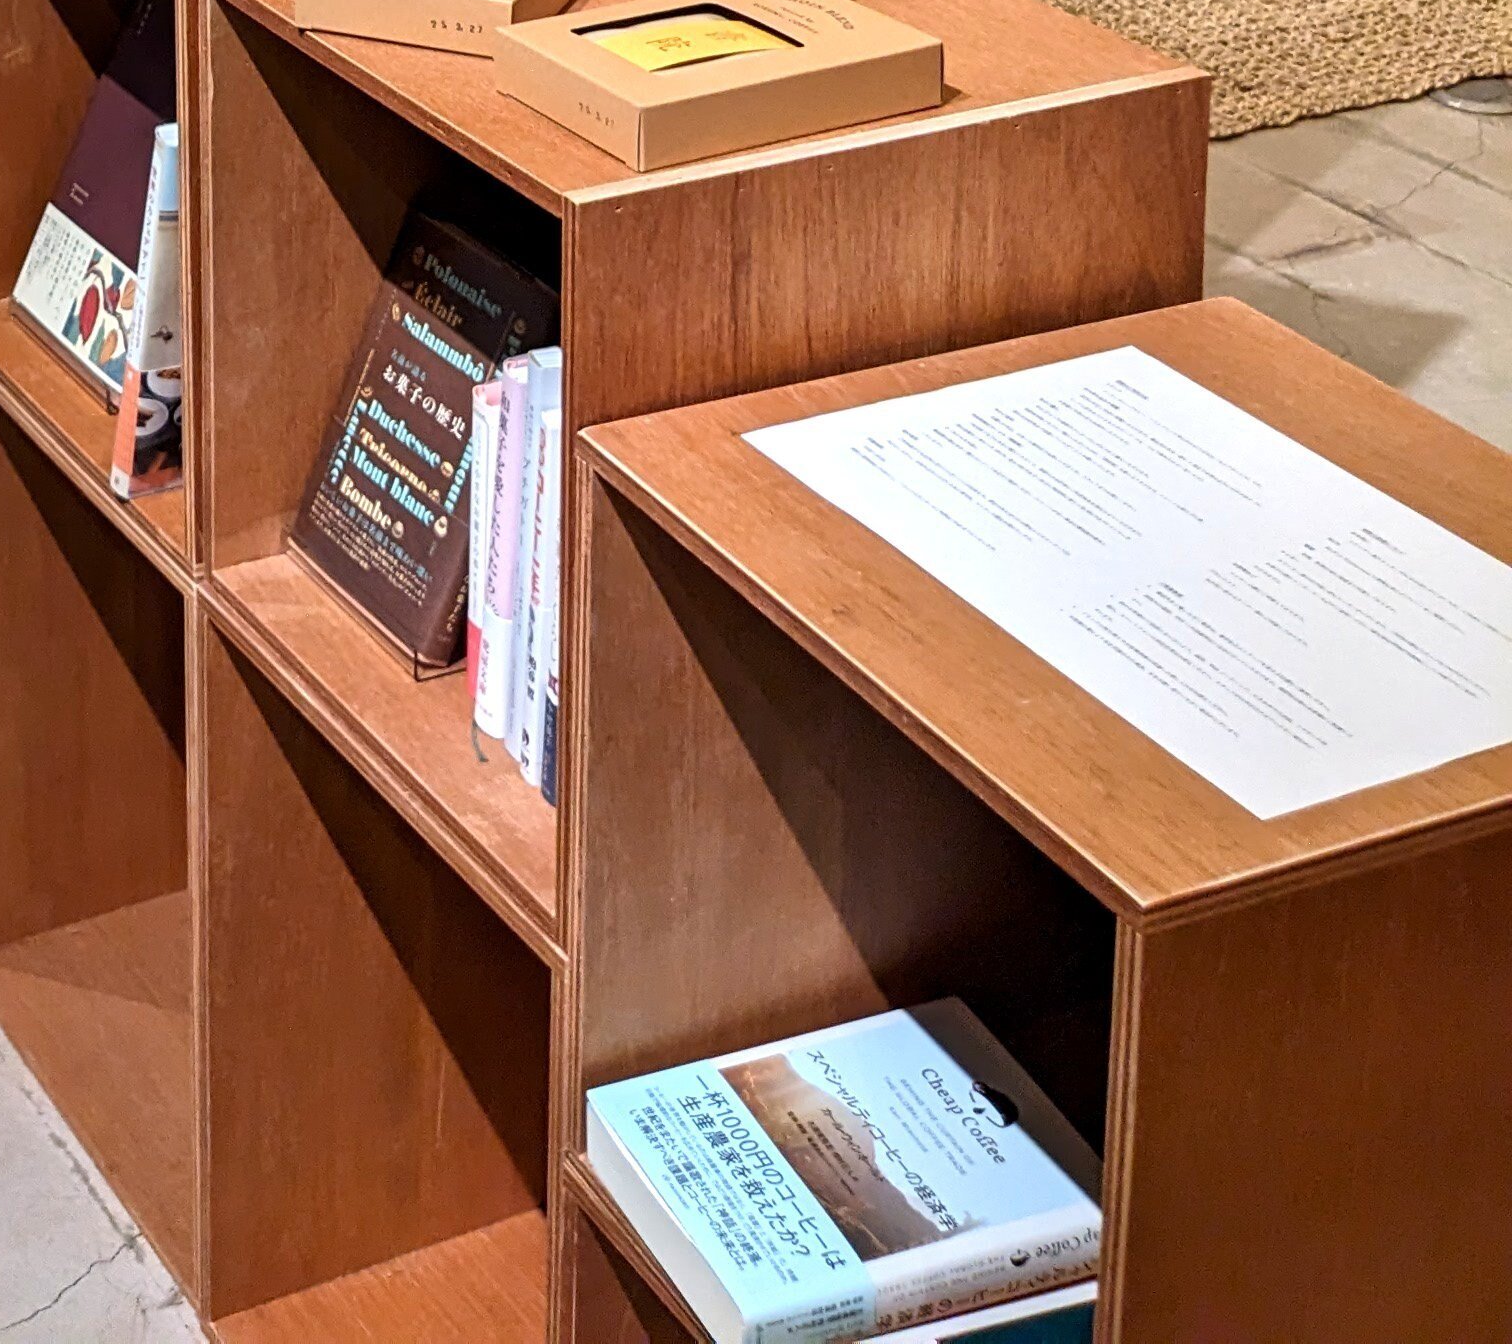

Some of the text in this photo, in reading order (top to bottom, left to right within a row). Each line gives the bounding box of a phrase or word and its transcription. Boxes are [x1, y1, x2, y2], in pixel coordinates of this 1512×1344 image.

[423, 253, 502, 318] Polonaise
[402, 312, 485, 383] Salammbô
[368, 398, 441, 469] Duchesse
[382, 364, 466, 442] お菓子の歴史
[340, 474, 392, 530] Bombe
[349, 444, 389, 491] Mont
[390, 477, 435, 528] blanc
[807, 1050, 959, 1231] スペシャルティコーヒーの経済学
[922, 1068, 1005, 1164] Cheap Coffee
[696, 1075, 846, 1269] 一杯1000円のコーヒーは
